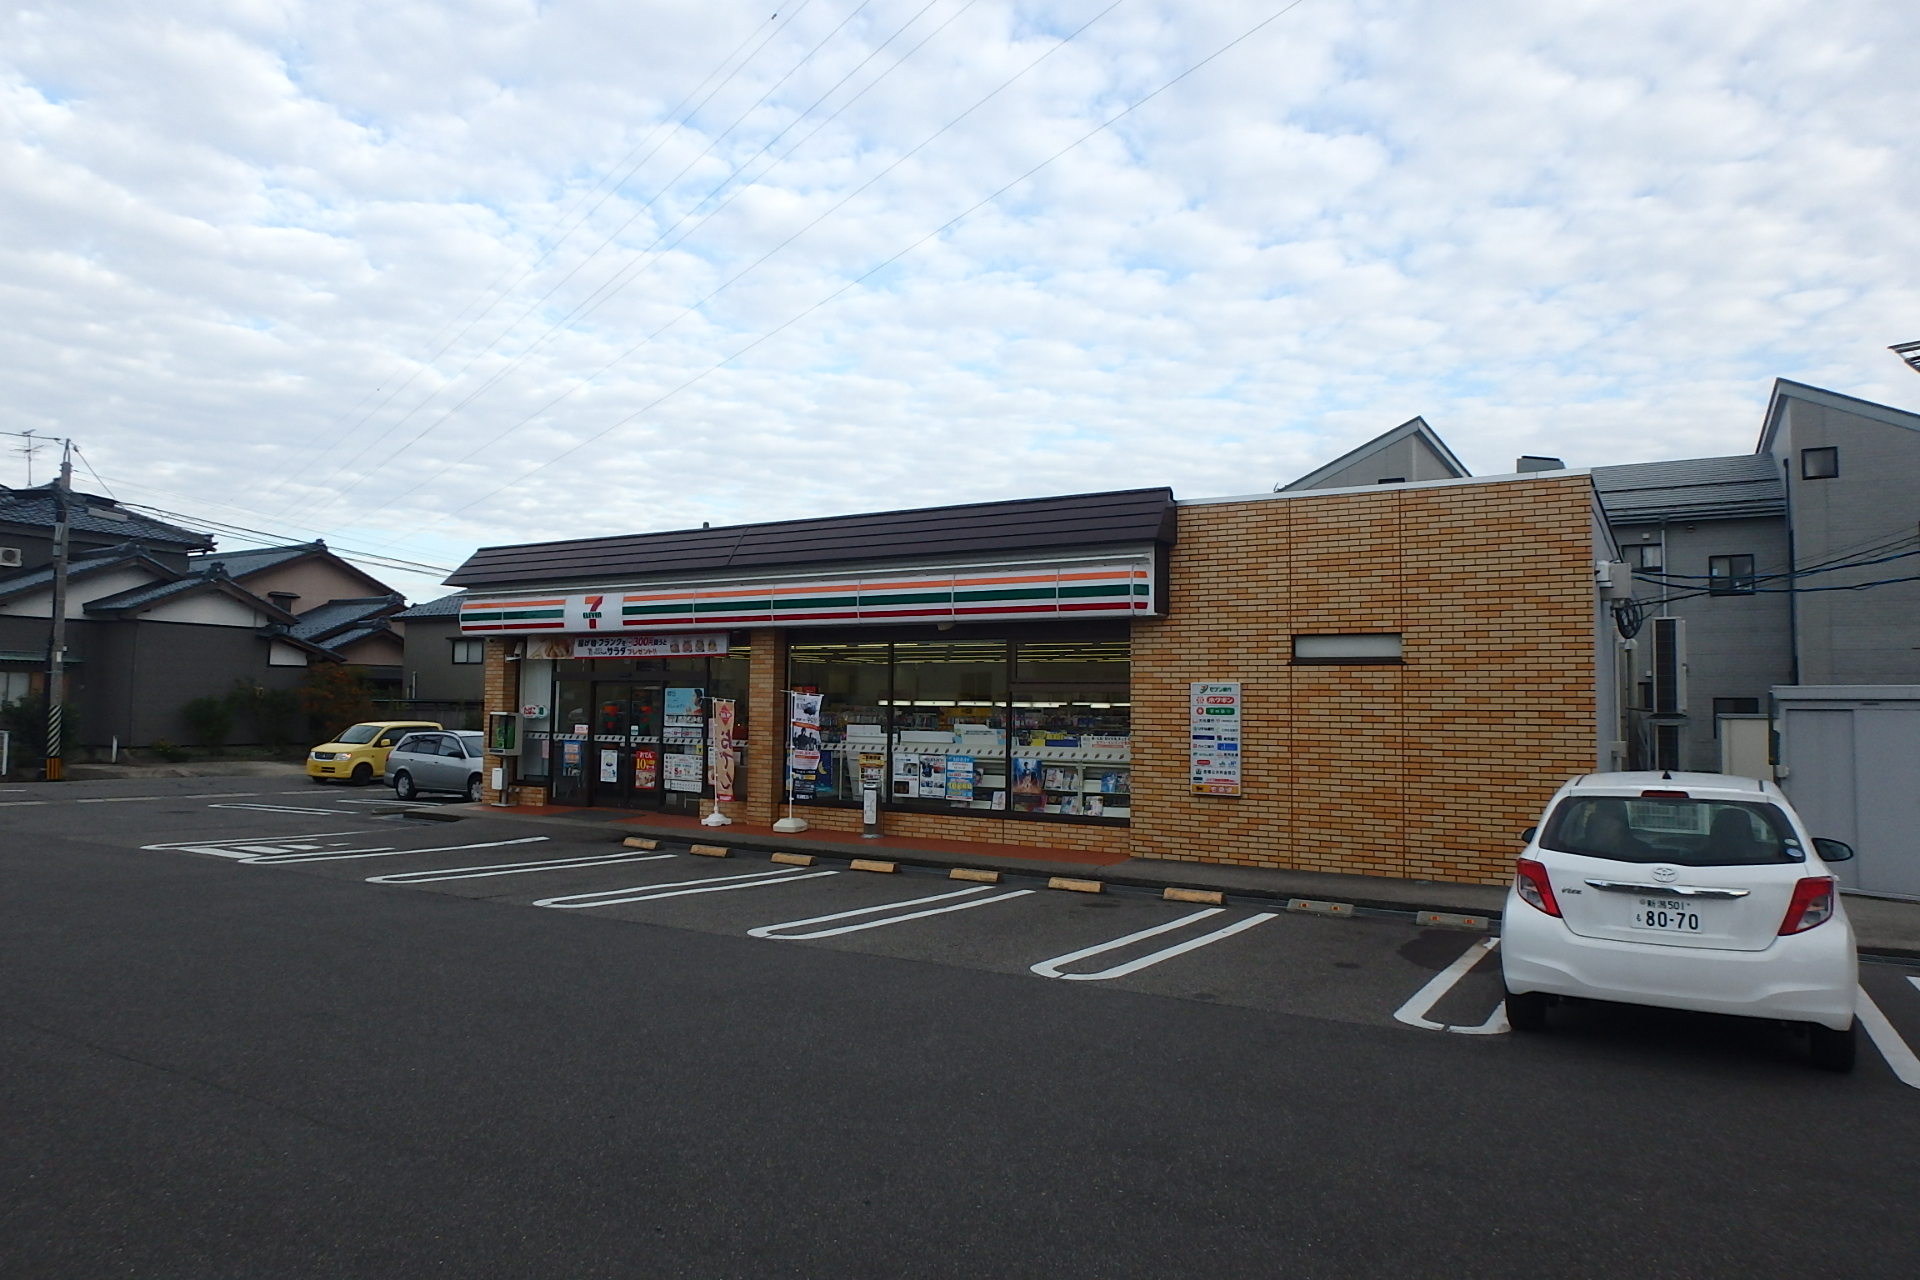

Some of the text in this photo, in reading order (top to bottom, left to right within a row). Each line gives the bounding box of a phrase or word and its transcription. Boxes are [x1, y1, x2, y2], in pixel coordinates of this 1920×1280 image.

[584, 595, 604, 629] 7
[1667, 901, 1685, 911] 501
[1645, 910, 1699, 930] 80-70
